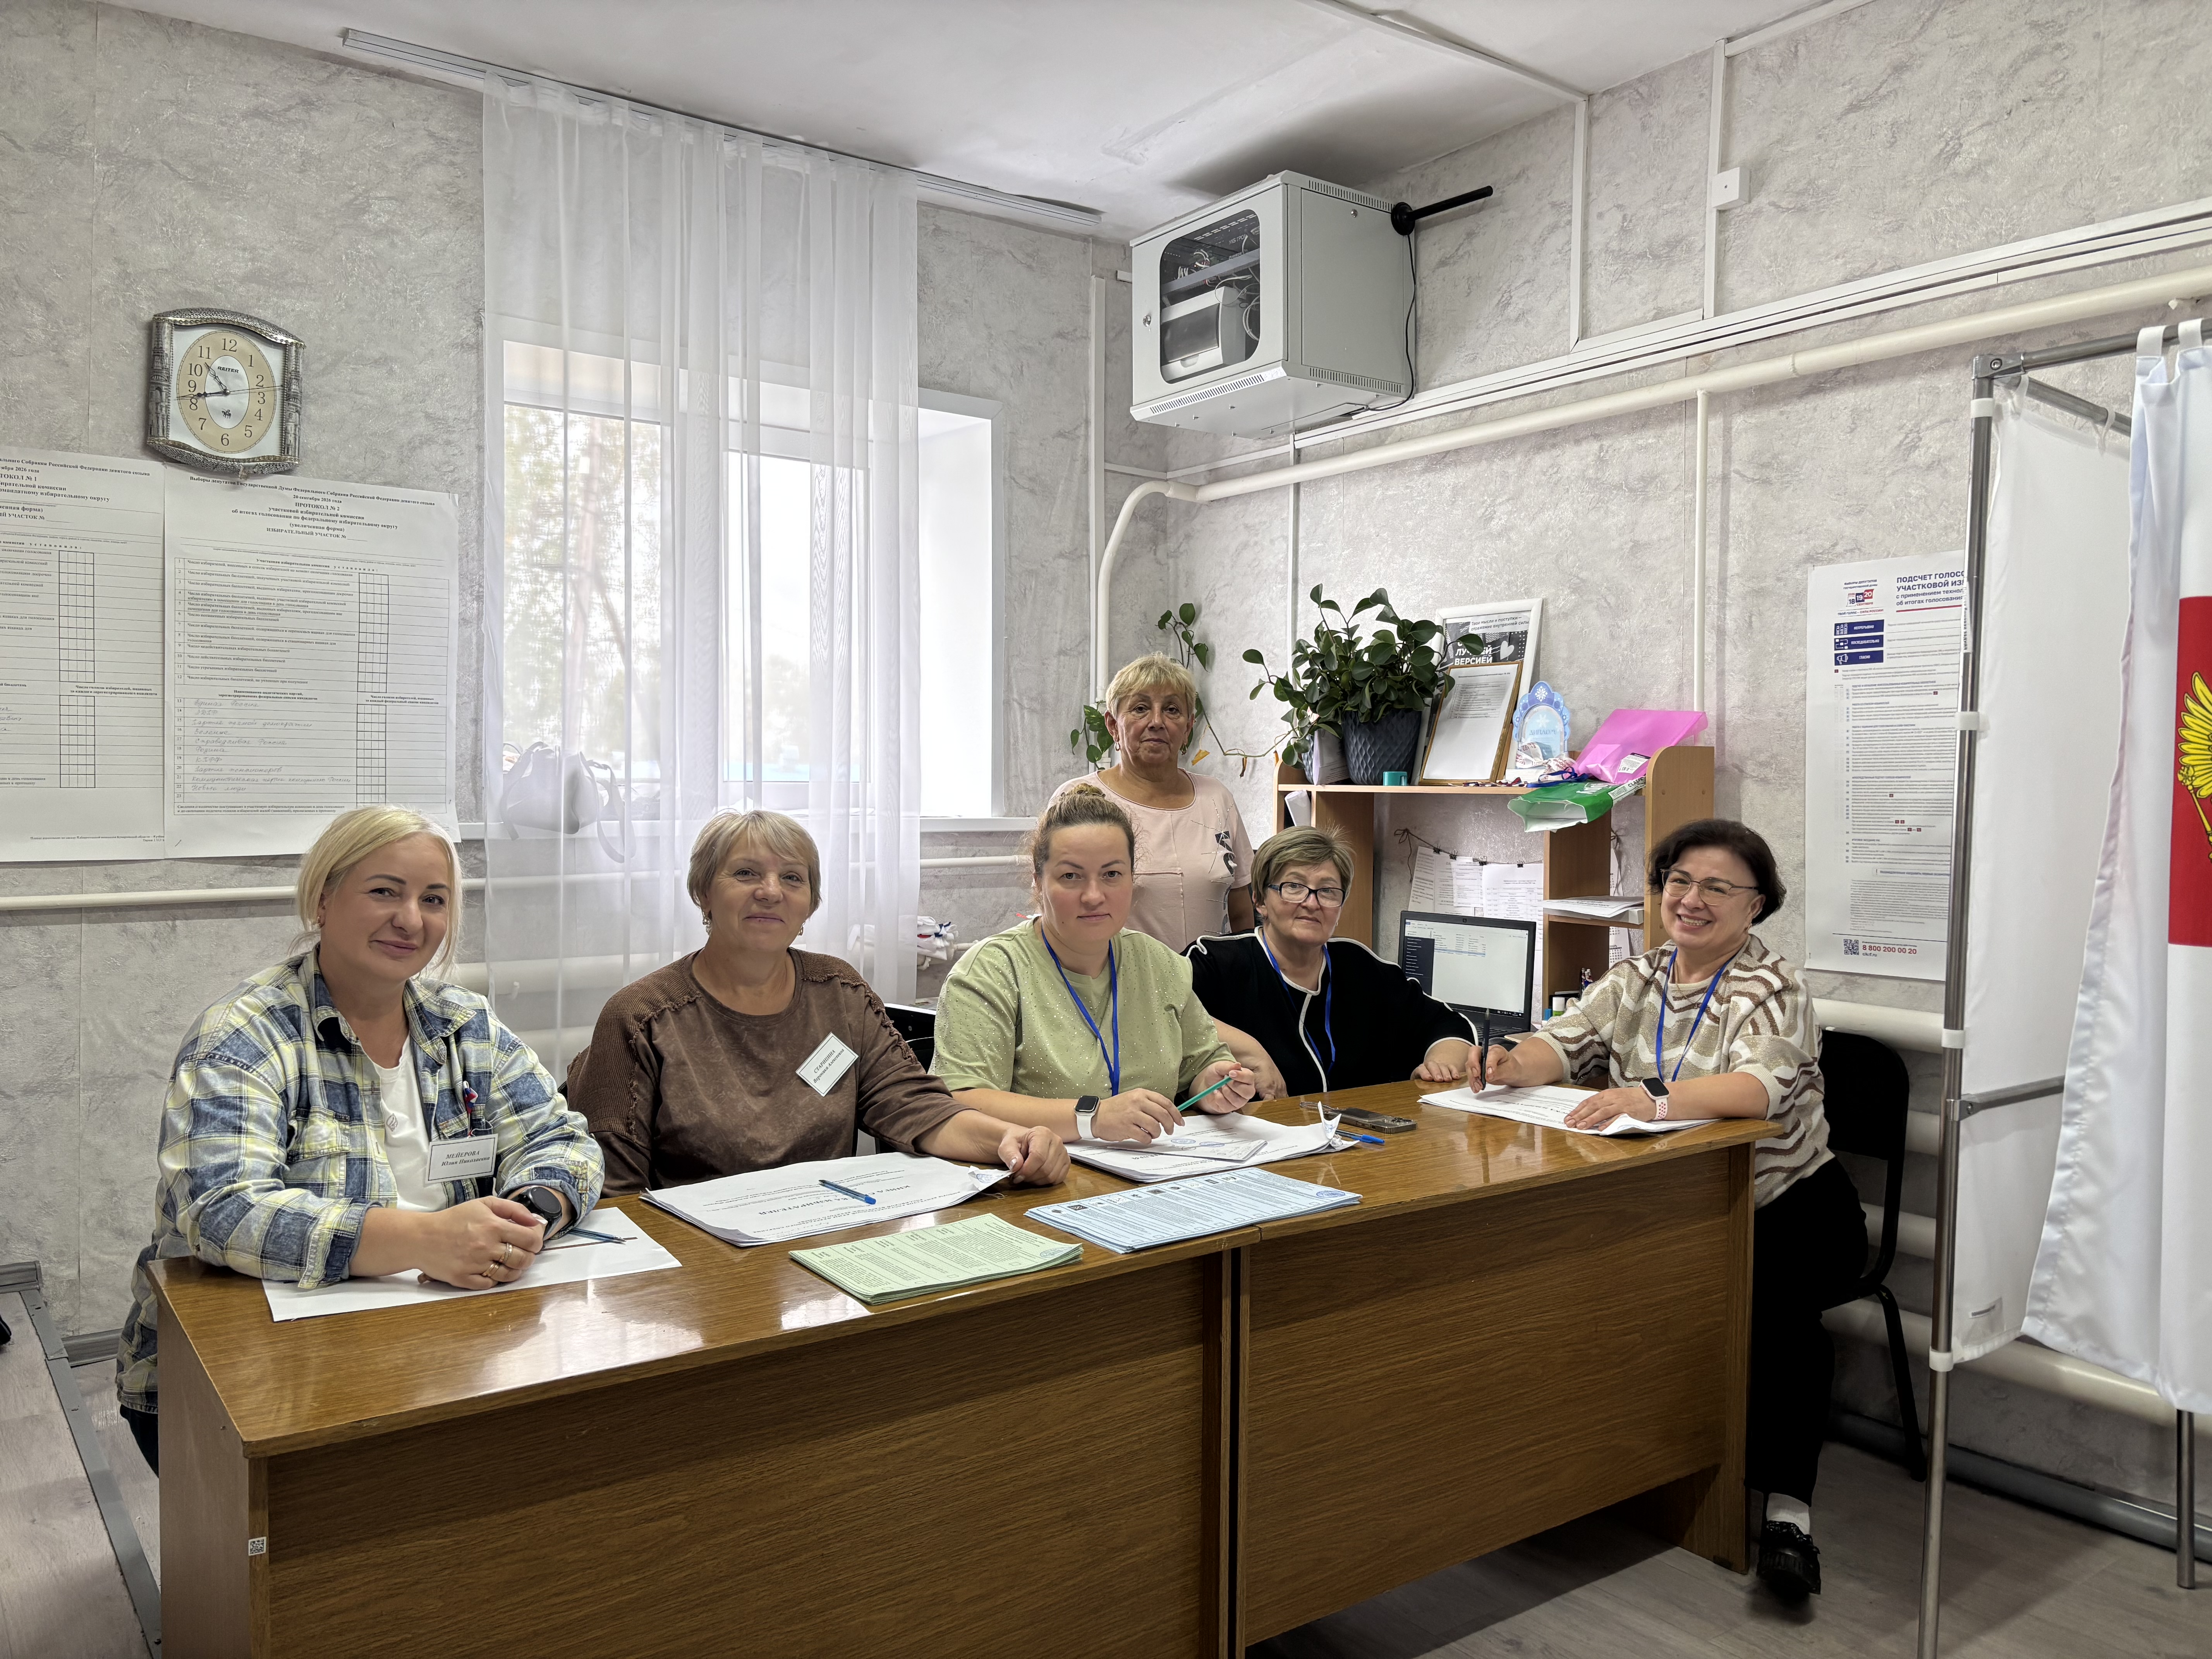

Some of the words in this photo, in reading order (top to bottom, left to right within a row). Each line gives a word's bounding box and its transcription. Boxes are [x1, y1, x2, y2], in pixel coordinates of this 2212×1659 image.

[222, 338, 237, 352] 12
[198, 346, 212, 359] 11
[248, 355, 254, 367] 1
[188, 364, 202, 376] 10
[188, 380, 197, 392] 9
[256, 375, 264, 387] 2
[189, 397, 198, 410] 8
[258, 392, 265, 404] 3
[255, 409, 263, 421] 4
[199, 418, 206, 430] 7
[244, 426, 252, 437] 5
[221, 434, 229, 446] 6
[210, 477, 235, 486] депутатов
[236, 479, 277, 490] Государственной
[301, 516, 338, 524] федеральному
[266, 528, 314, 536] ИЗБИРАТЕЛЬНЫЙ
[1897, 574, 1932, 583] ПОДСЧЕТ
[1897, 581, 1949, 591] УЧАСТКОВОЙ
[1455, 655, 1492, 665] ВЕРСИЕЙ
[813, 1066, 829, 1083] Вероника
[828, 1049, 844, 1067] Алексеевна
[446, 1150, 479, 1159] МЕЙЕРОВА
[758, 1199, 833, 1215] ИЗБИРАТЕЛЕЙ
